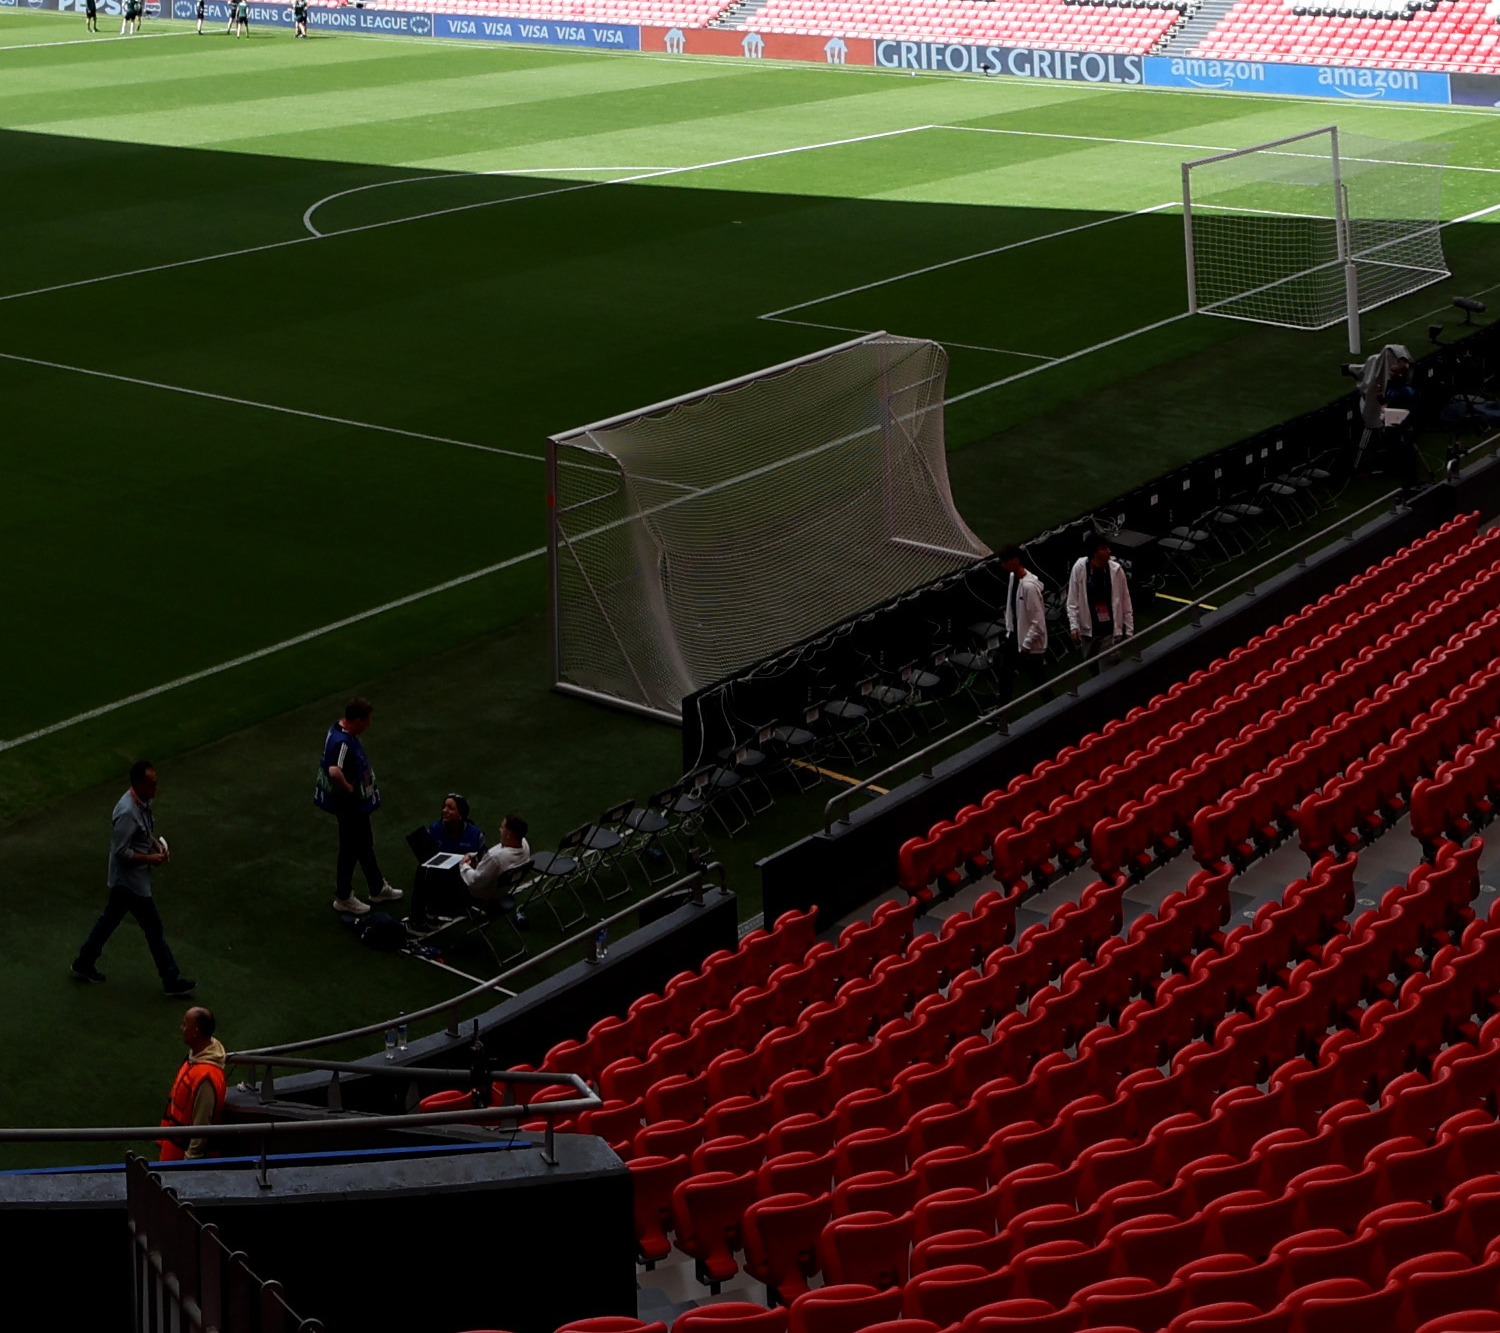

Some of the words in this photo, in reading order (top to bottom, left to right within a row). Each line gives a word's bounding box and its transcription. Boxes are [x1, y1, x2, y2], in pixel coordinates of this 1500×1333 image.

[360, 15, 408, 30] LEAGUE
[448, 20, 476, 34] VISA
[482, 22, 512, 36] VISA
[518, 24, 549, 39] VISA
[555, 26, 586, 41] VISA
[592, 28, 624, 44] VISA
[877, 40, 1002, 75] GRIFOLS
[1008, 48, 1141, 84] GRIFOLS
[1171, 58, 1265, 81] amazon
[1318, 66, 1418, 90] amazon
